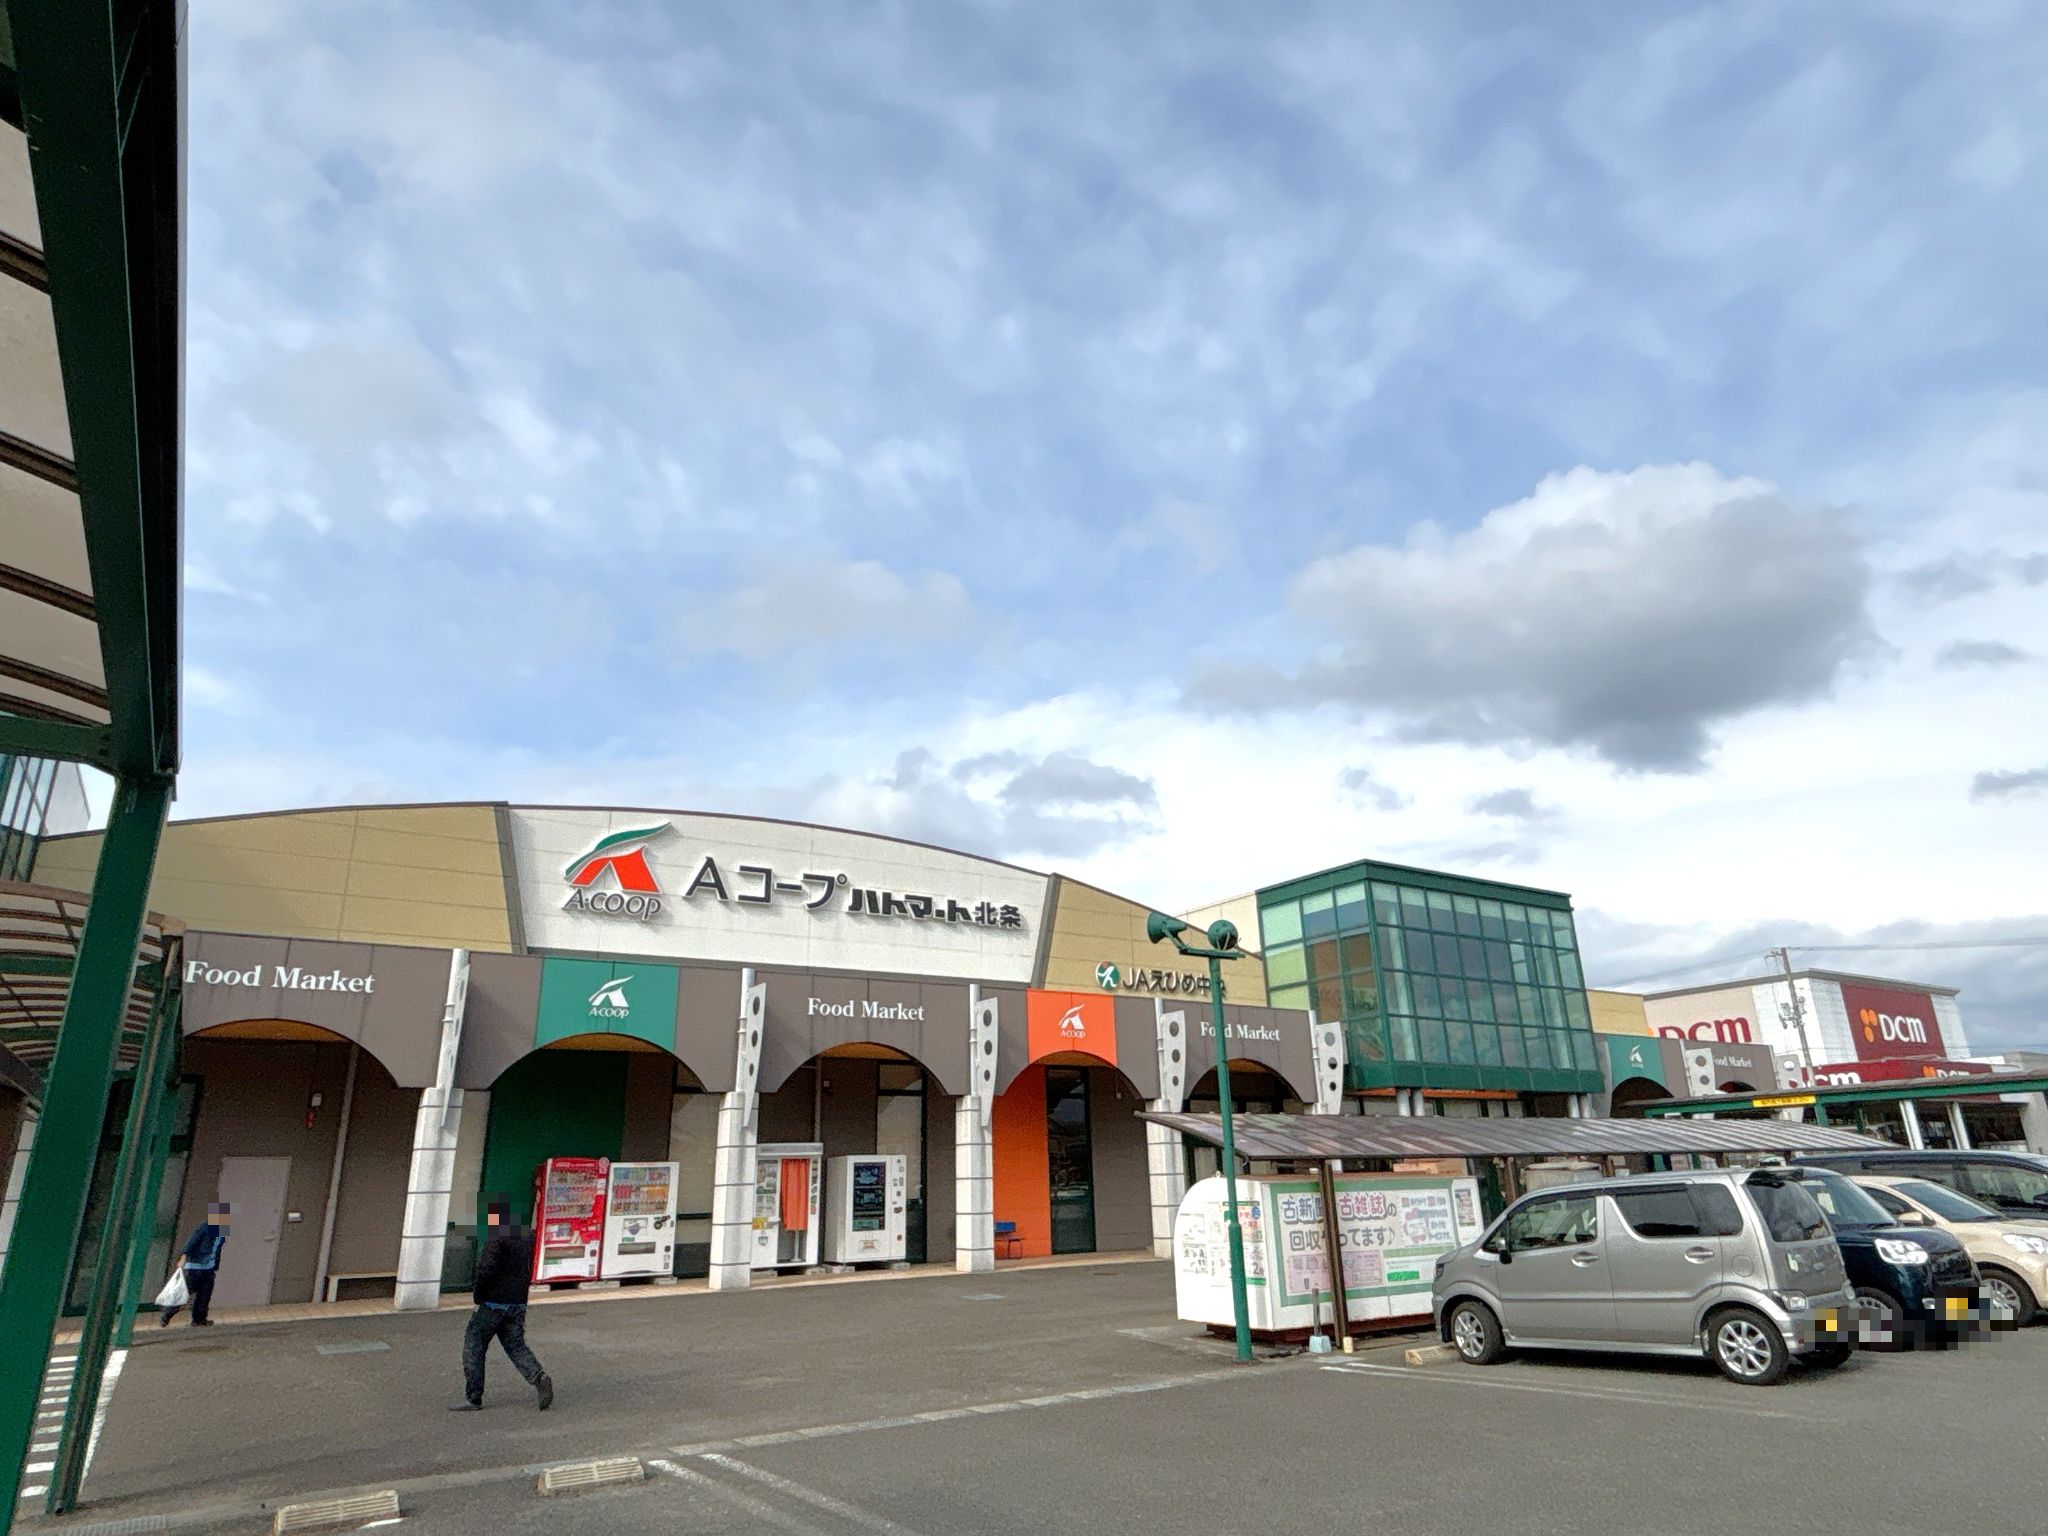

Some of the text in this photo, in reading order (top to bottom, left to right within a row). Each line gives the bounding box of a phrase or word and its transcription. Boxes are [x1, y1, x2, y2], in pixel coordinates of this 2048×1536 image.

[184, 960, 376, 993] Food Market
[807, 997, 925, 1021] Food Market
[1200, 1021, 1281, 1041] Fod Market
